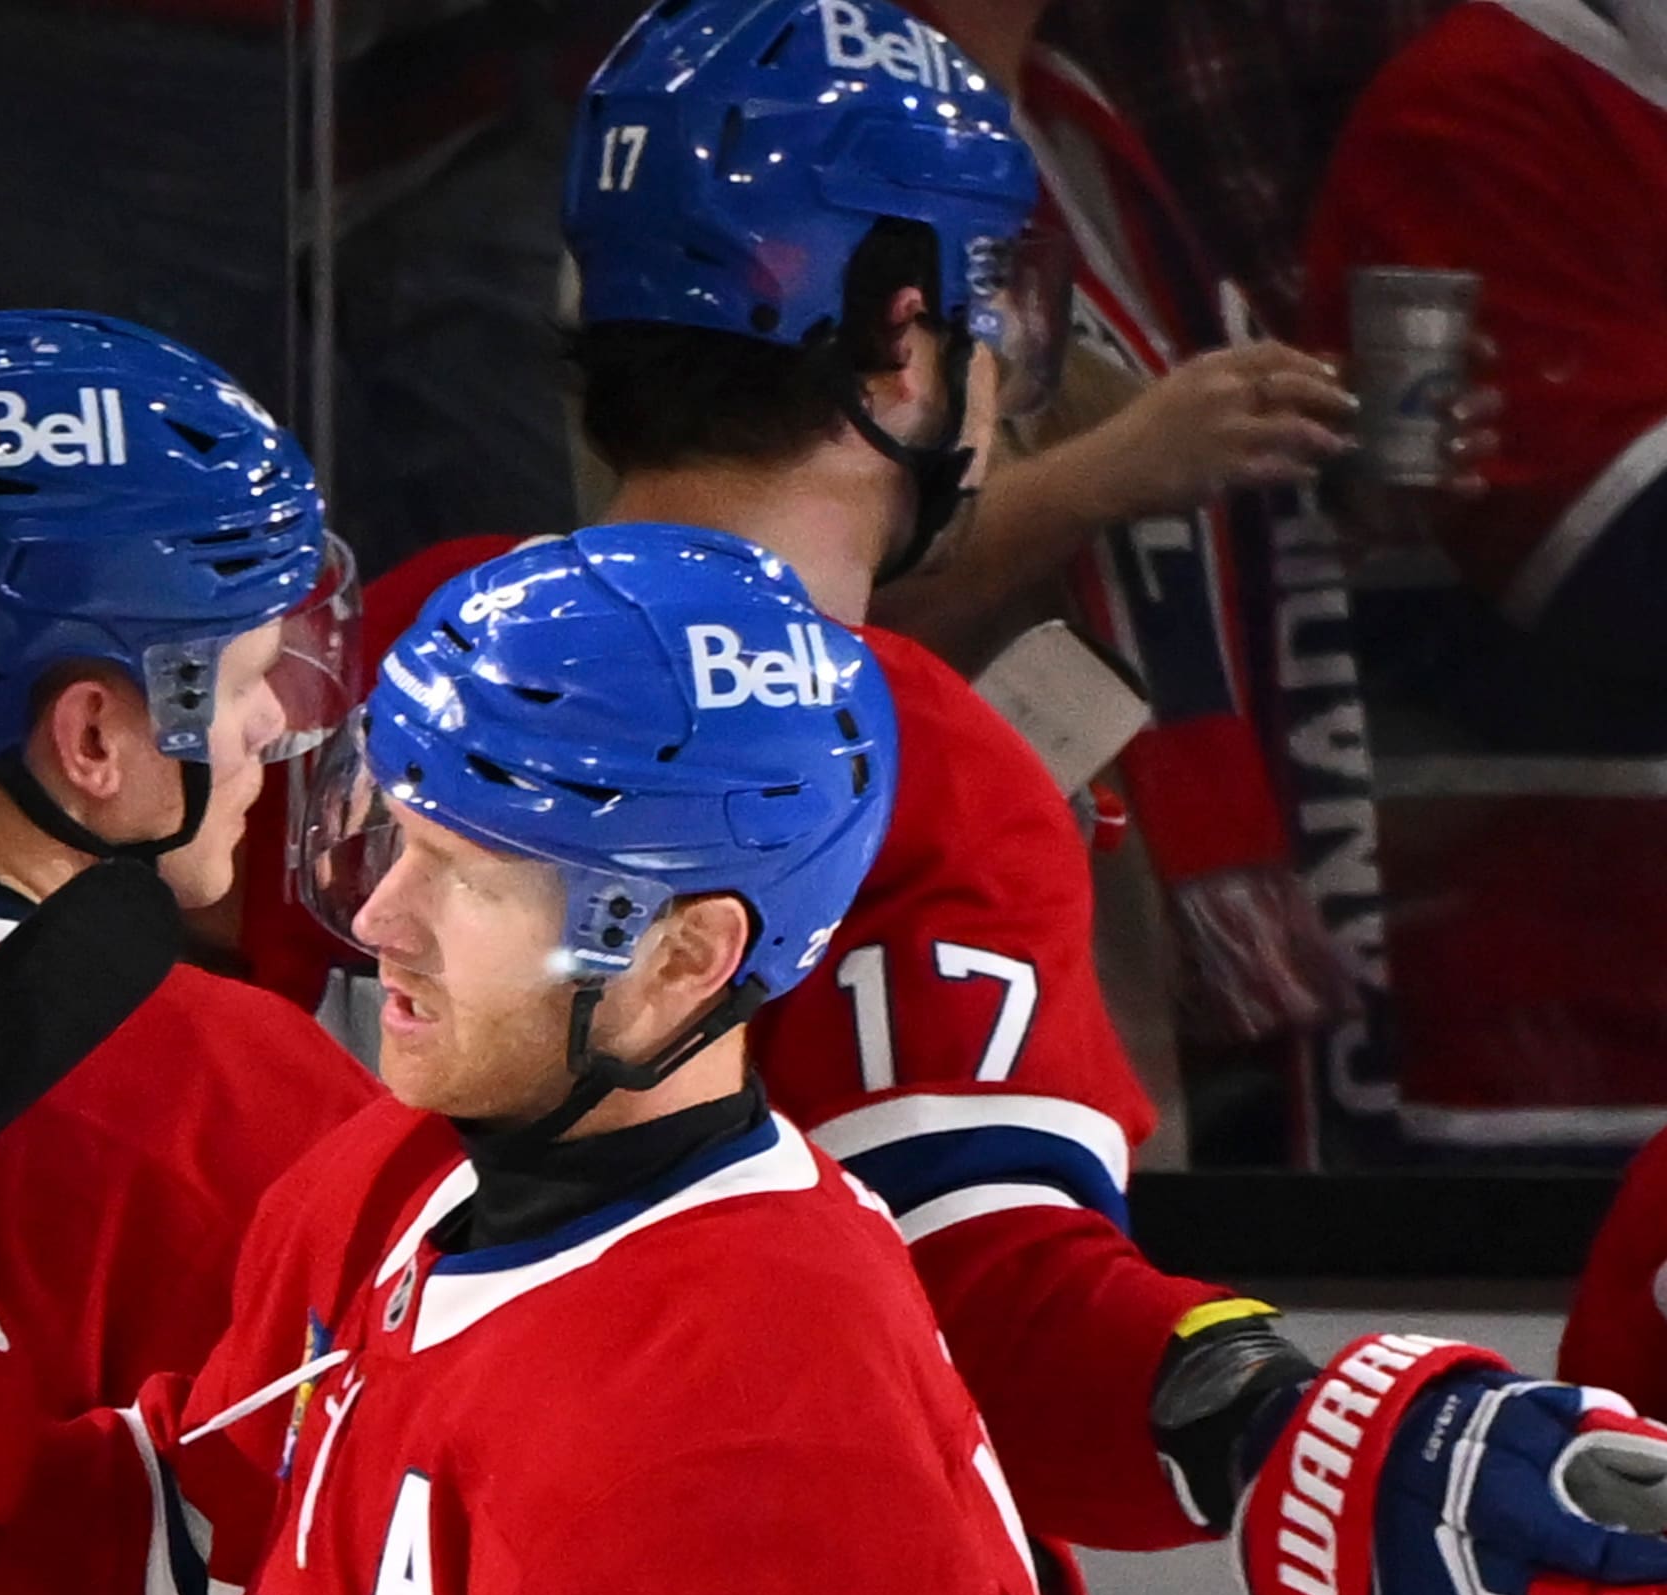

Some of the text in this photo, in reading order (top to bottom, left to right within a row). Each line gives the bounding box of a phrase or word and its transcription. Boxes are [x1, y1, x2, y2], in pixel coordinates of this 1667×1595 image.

[817, 0, 950, 93] Bell
[597, 125, 648, 191] 17
[686, 624, 840, 709] Bell
[834, 940, 1039, 1092] 17
